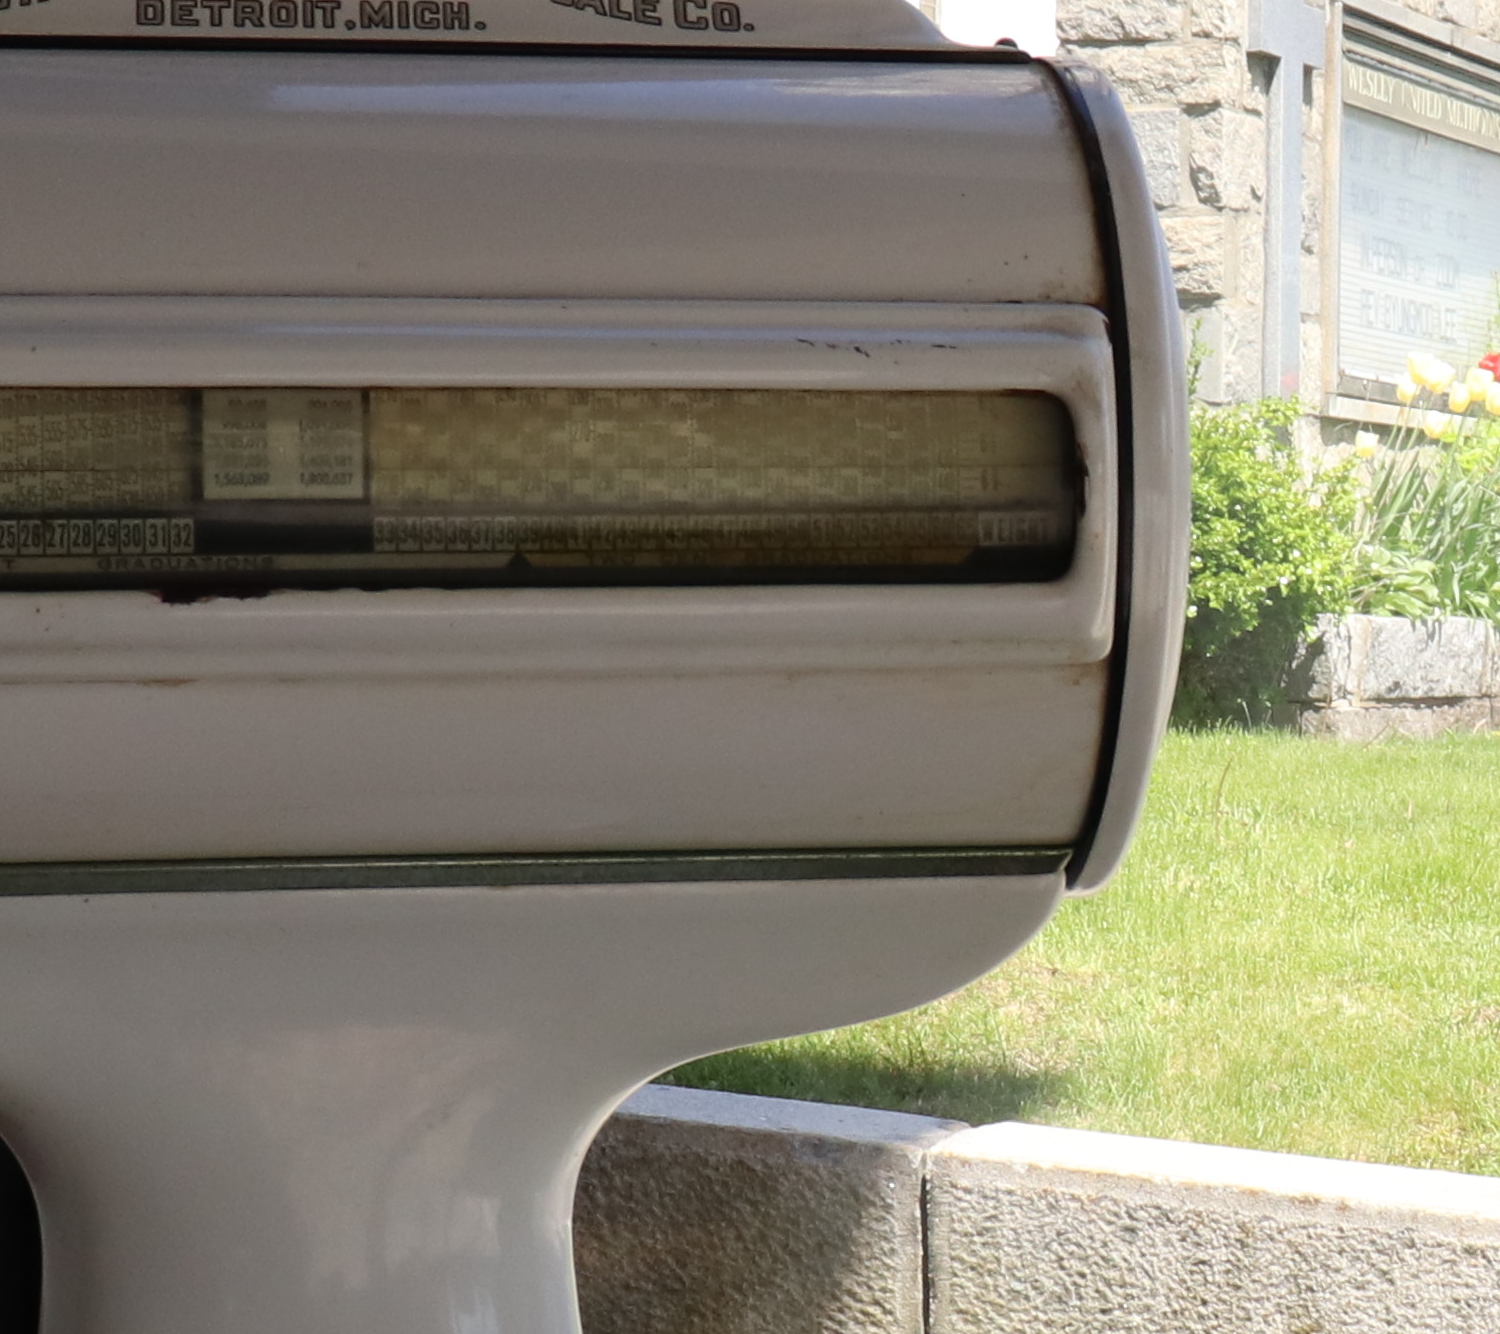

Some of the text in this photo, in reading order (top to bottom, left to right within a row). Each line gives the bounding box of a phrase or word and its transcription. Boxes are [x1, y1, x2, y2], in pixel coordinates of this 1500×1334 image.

[1347, 62, 1395, 104] WESLEY
[1400, 80, 1442, 119] UNITED
[20, 524, 41, 550] 26
[46, 524, 67, 549] 27
[72, 524, 92, 549] 28
[97, 524, 117, 549] 29
[122, 524, 142, 549] 30
[148, 524, 168, 549] 31
[172, 524, 193, 549] 32
[96, 556, 274, 572] GRADUATIONS
